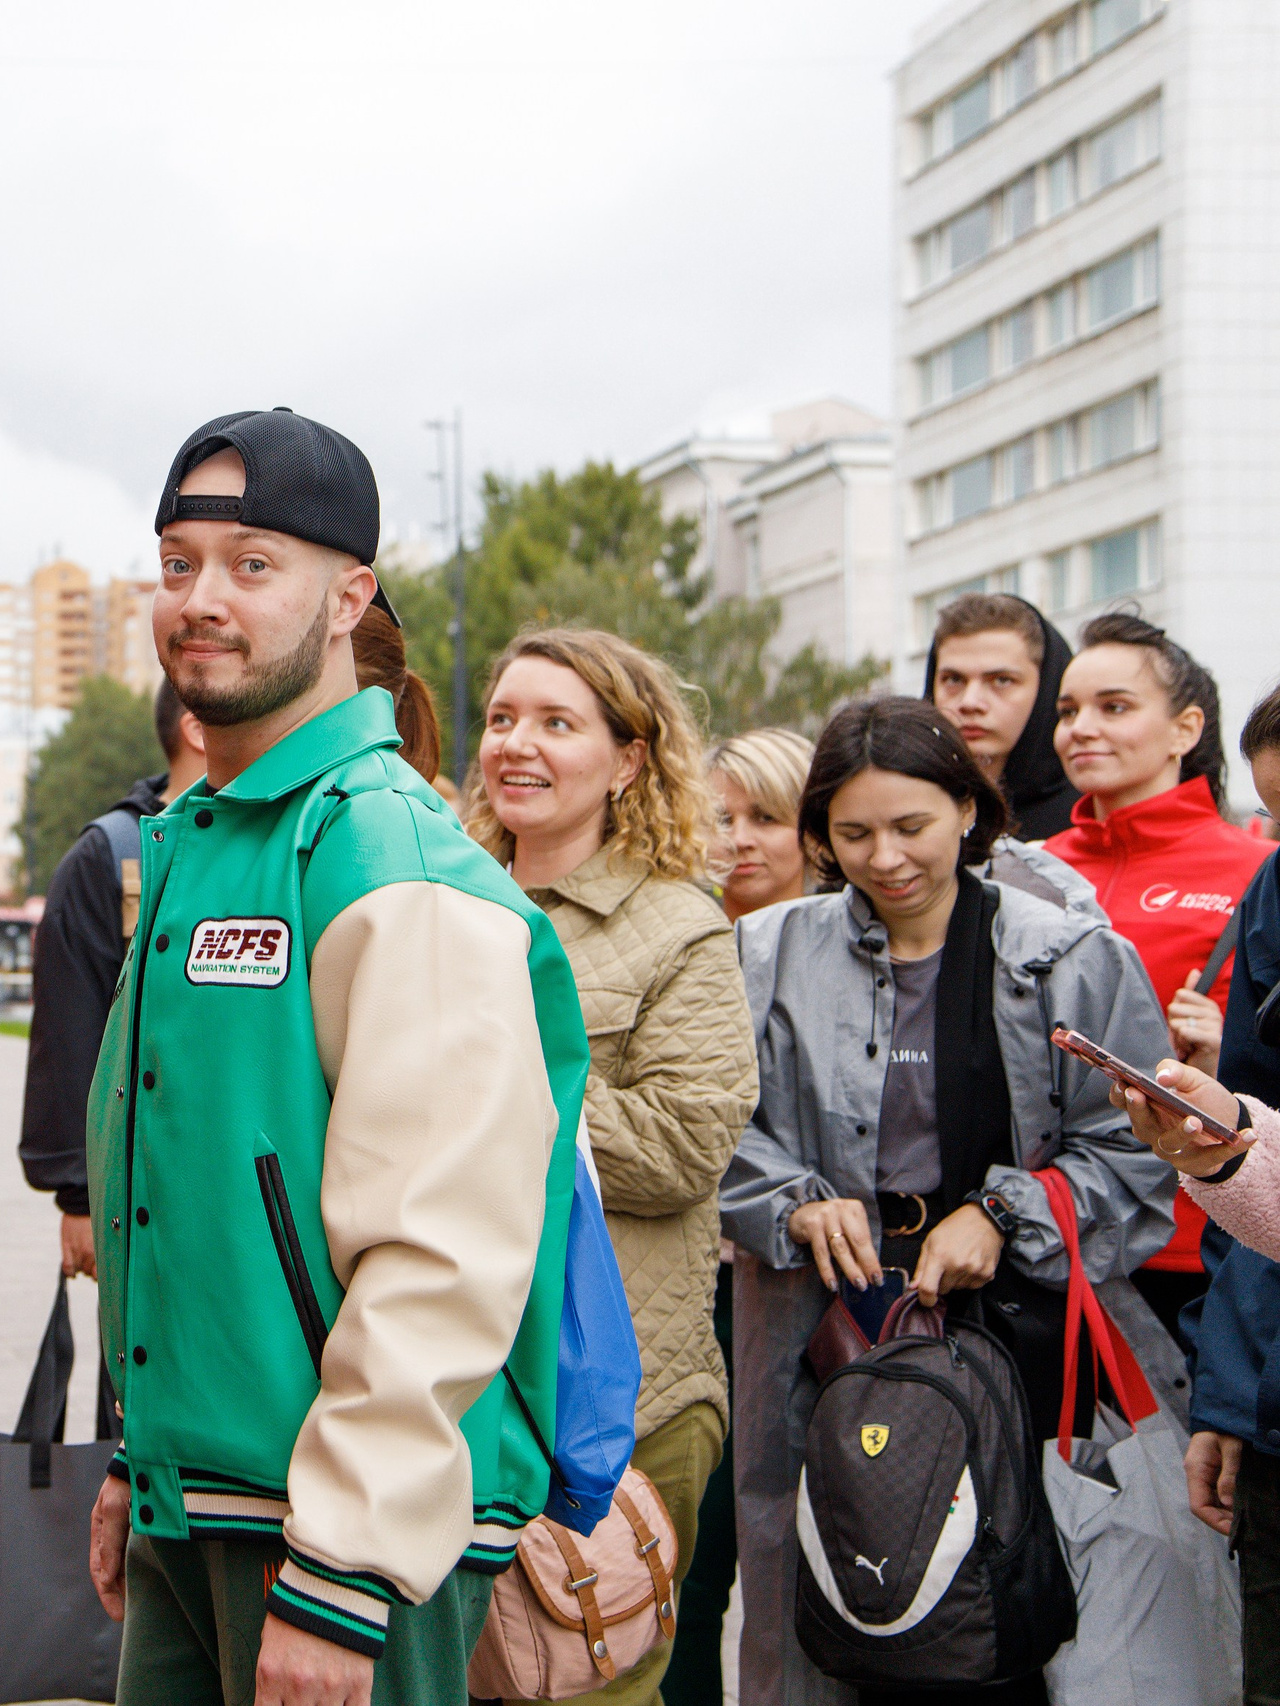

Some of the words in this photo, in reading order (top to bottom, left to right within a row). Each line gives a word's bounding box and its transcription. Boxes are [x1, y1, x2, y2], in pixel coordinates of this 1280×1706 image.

[195, 928, 283, 961] NCFS
[190, 963, 237, 974] NAVIGATION
[240, 965, 280, 976] SYSTEM
